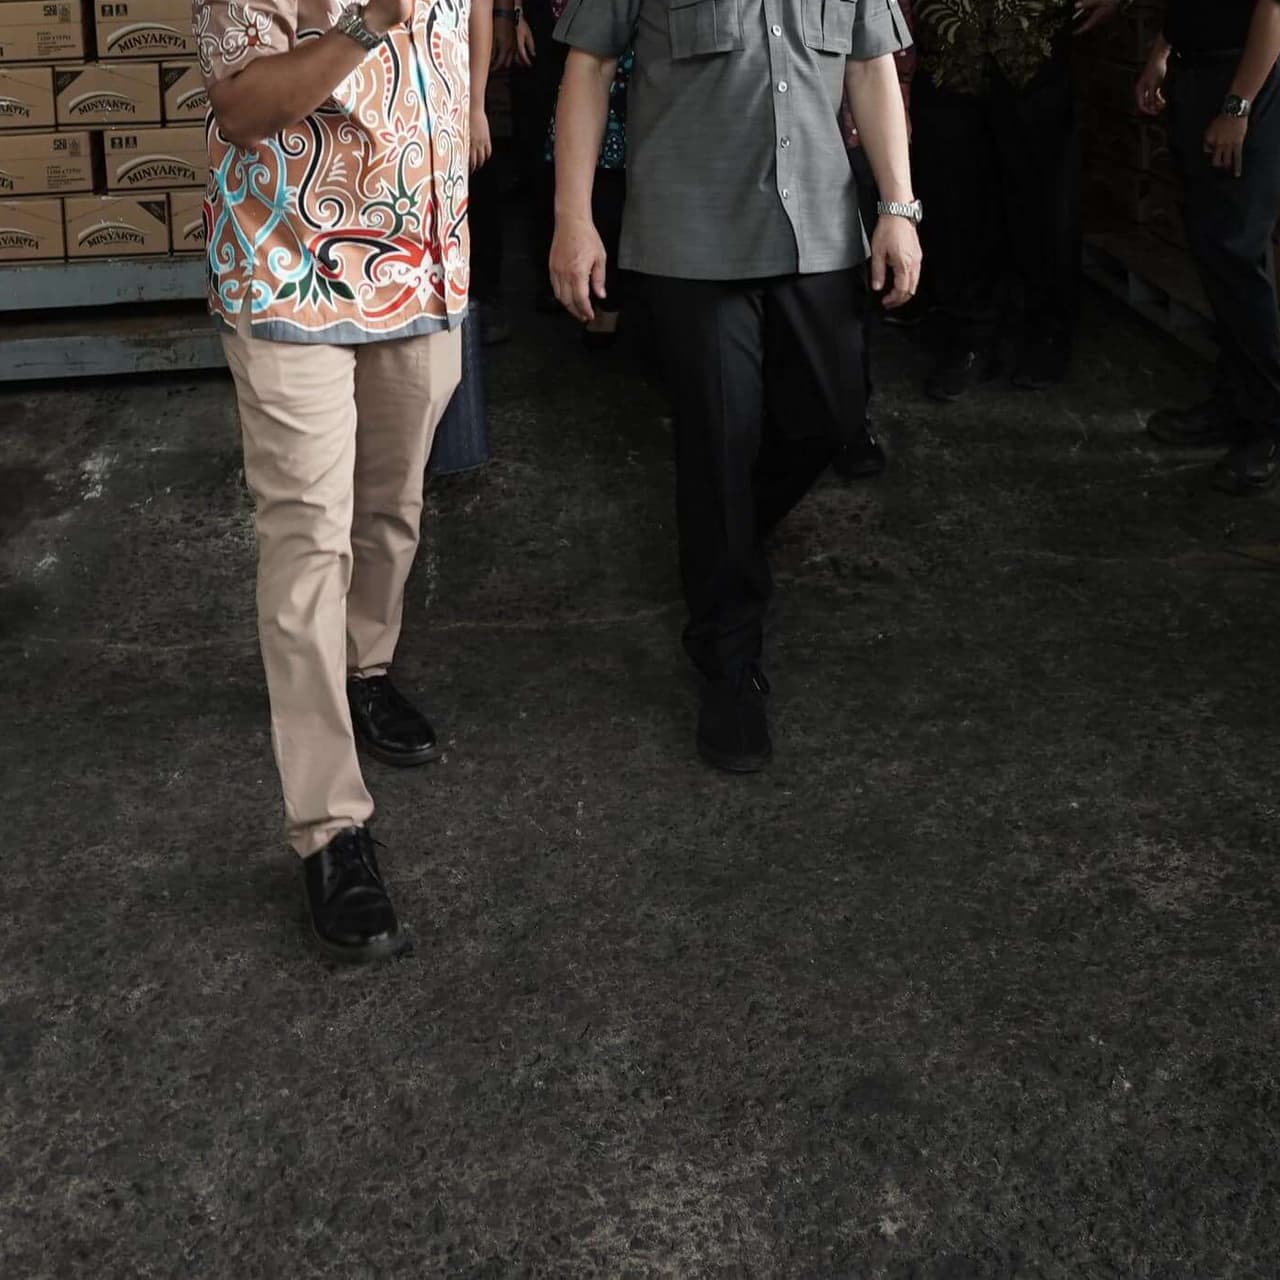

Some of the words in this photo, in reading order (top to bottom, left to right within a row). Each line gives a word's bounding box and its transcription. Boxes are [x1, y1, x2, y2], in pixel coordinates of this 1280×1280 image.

[118, 33, 187, 53] MINYAKITA
[78, 99, 136, 115] MINYAKITA
[127, 166, 196, 185] MINYAKITA
[87, 230, 145, 248] MINYAKITA
